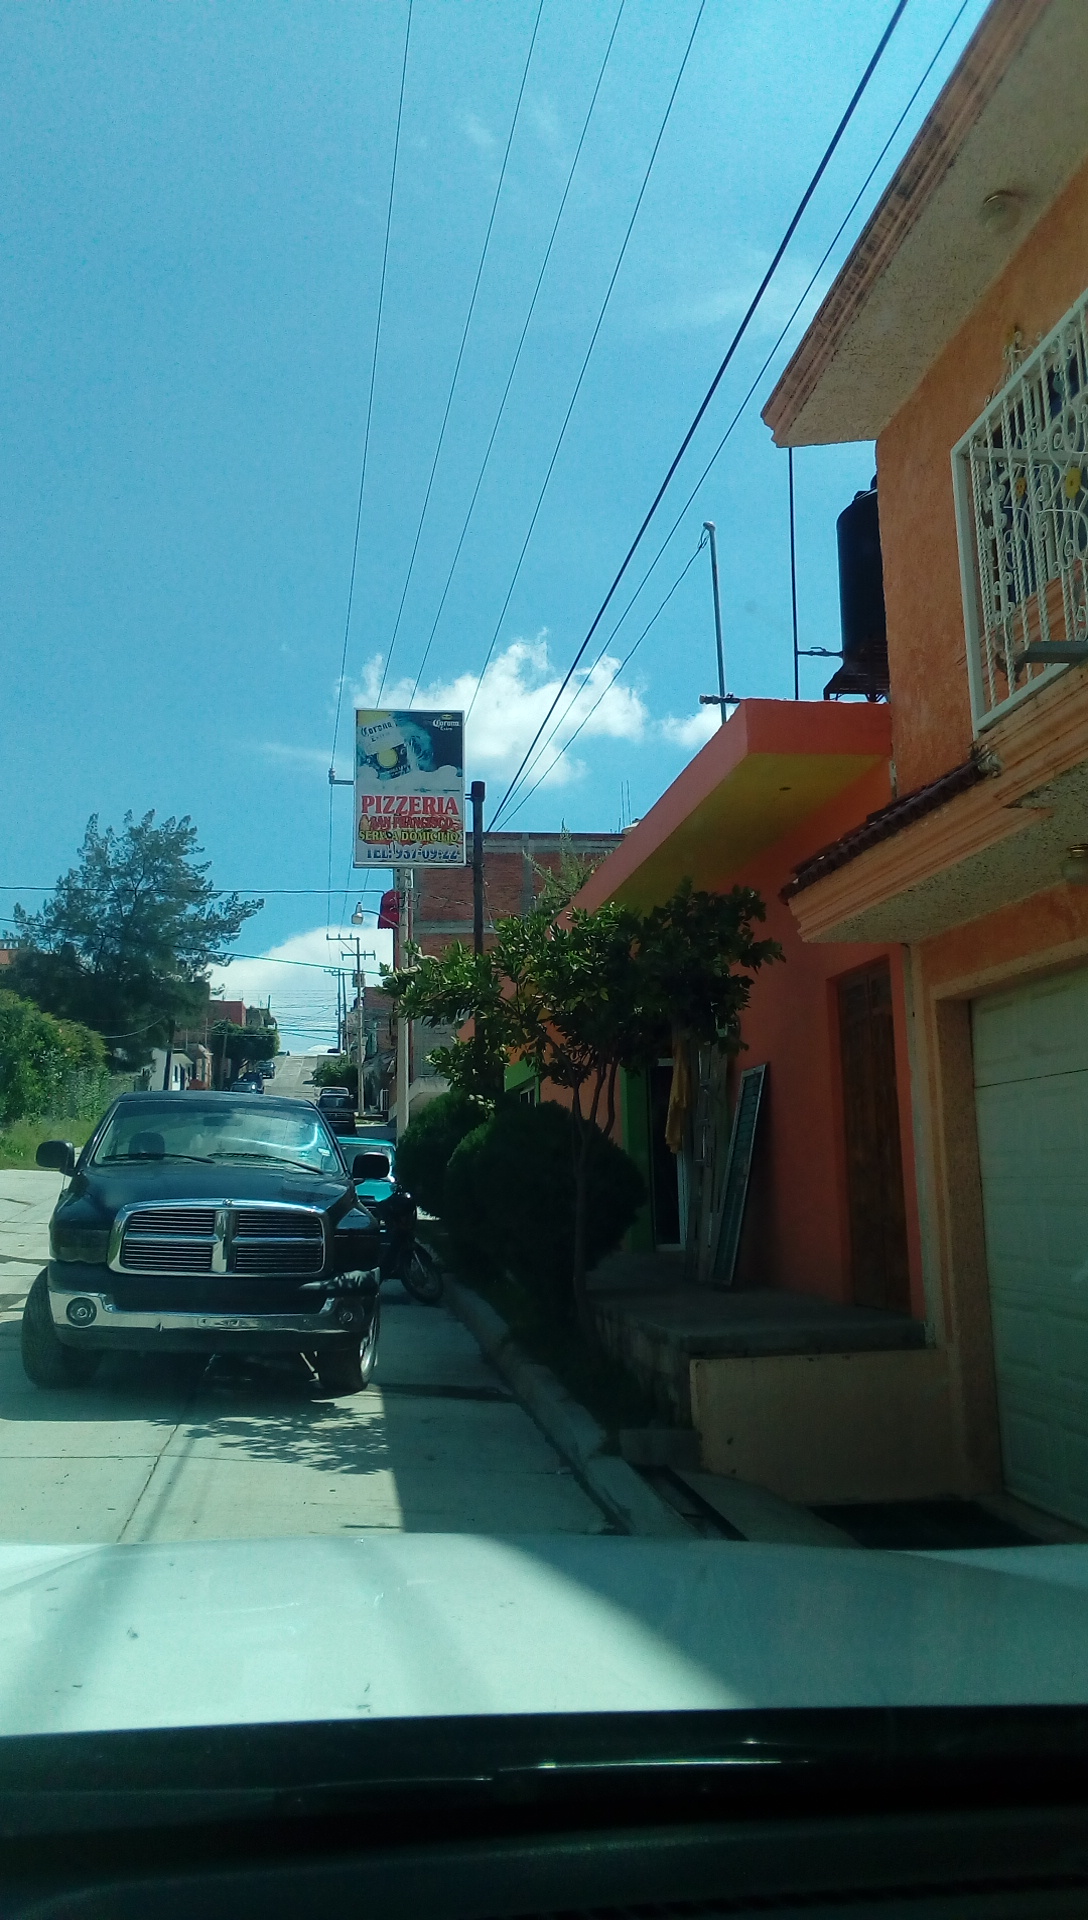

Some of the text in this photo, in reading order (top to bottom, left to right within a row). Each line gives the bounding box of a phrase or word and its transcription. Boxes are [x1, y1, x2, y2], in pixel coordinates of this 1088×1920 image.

[361, 721, 392, 737] Corona
[433, 719, 460, 729] Corona
[361, 795, 459, 815] PIZZERIA
[369, 815, 391, 830] SAN
[401, 831, 460, 842] DOMICILIO
